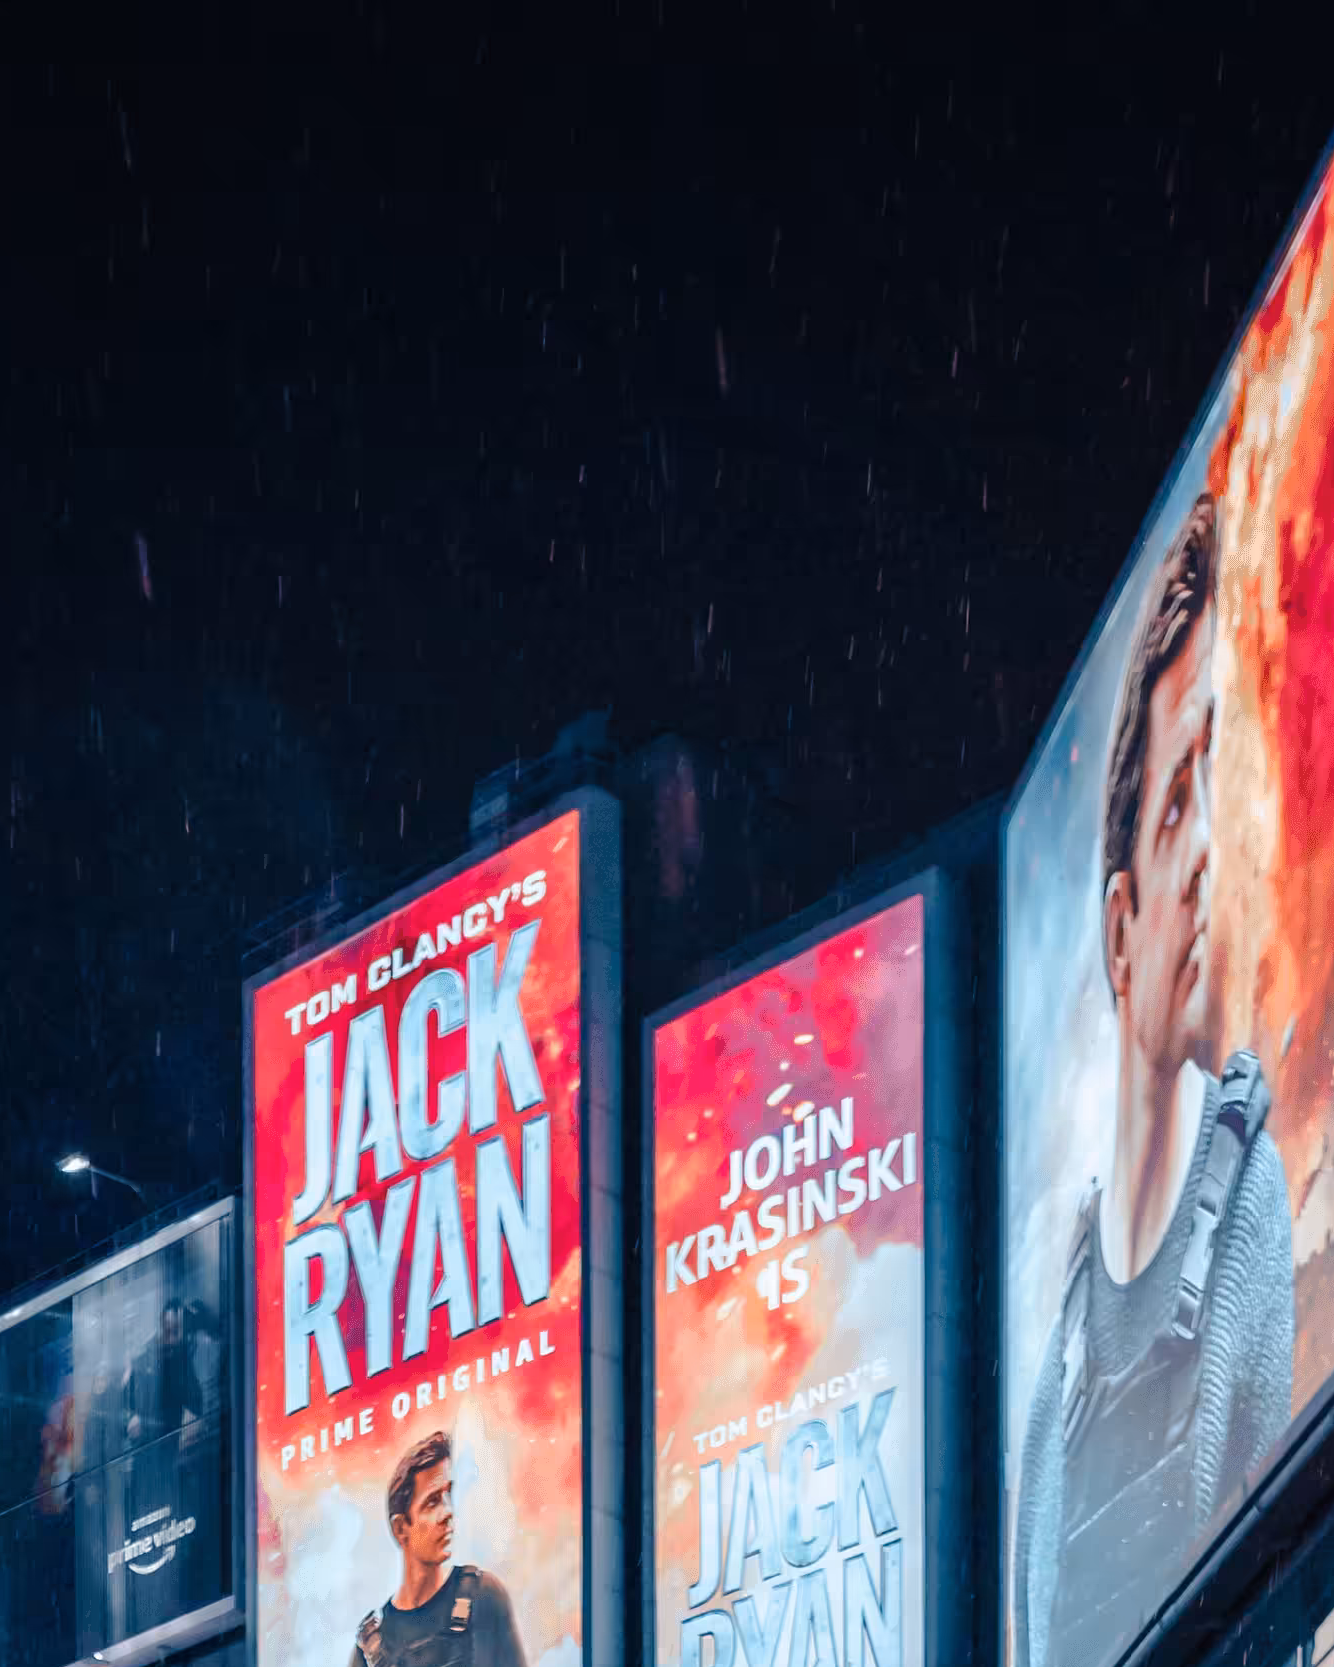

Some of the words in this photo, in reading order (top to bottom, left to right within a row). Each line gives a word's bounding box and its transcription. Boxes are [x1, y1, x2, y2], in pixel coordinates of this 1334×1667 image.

[284, 972, 357, 1036] TOM
[368, 870, 547, 994] CLANCY'S
[294, 919, 543, 1225] JACK
[666, 1132, 917, 1294] KRASINSKI
[720, 1097, 855, 1208] JOHN
[284, 1112, 551, 1417] RYAN
[764, 1247, 810, 1309] IS
[281, 1407, 373, 1472] PRIME
[392, 1330, 556, 1421] ORIGINAL
[693, 1416, 747, 1455] TOM
[756, 1357, 889, 1429] CLANCY'S
[107, 1536, 153, 1574] prime
[153, 1514, 197, 1551] video
[130, 1507, 171, 1531] amazon
[688, 1386, 898, 1609] JACK
